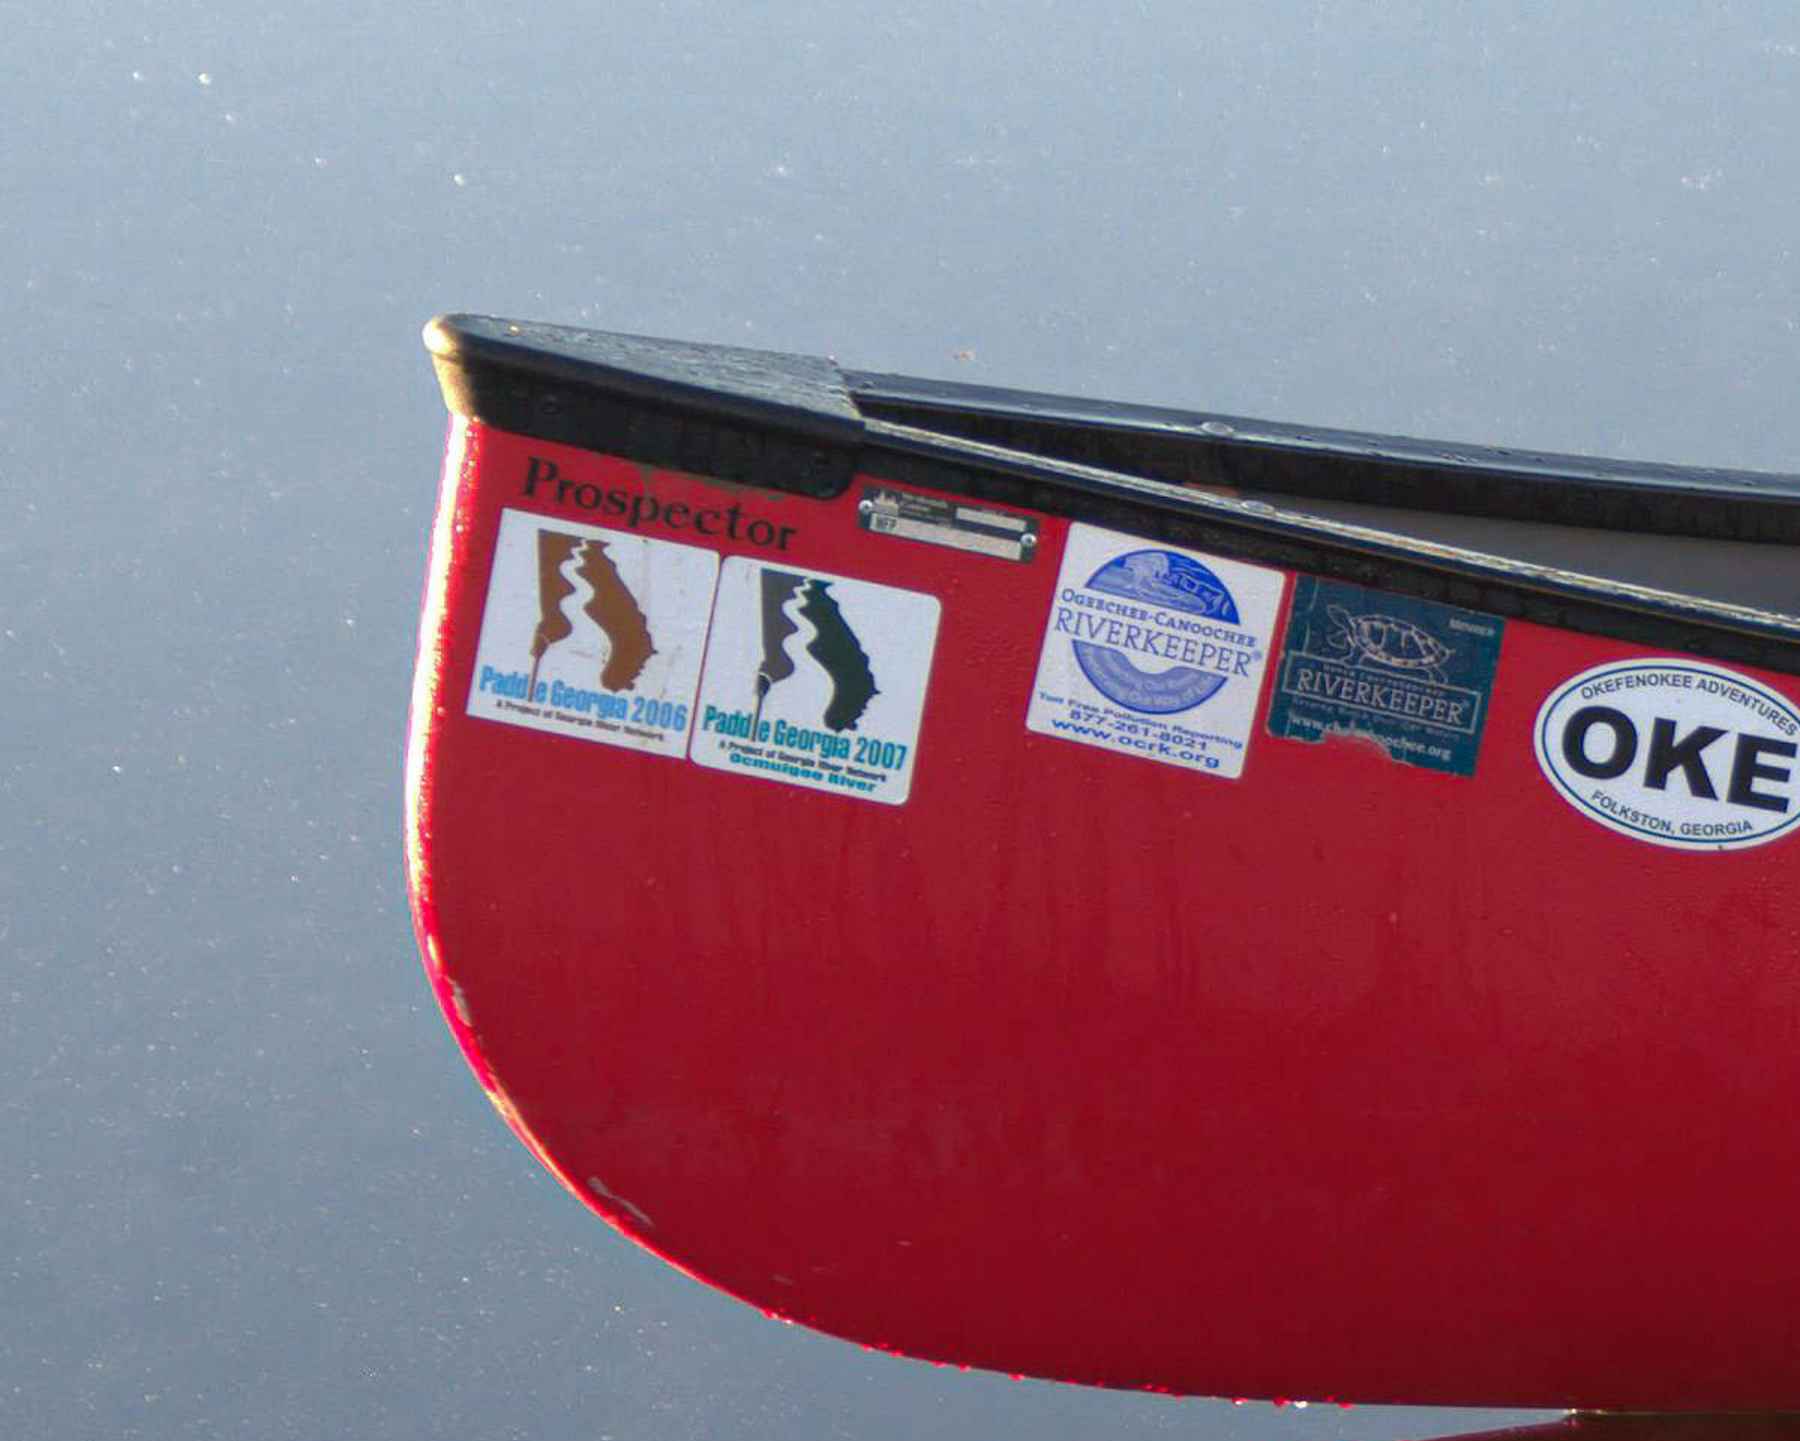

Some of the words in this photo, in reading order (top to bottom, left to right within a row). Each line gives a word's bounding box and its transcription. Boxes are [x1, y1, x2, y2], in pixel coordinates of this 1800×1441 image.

[523, 456, 798, 550] Prospector
[1054, 605, 1252, 678] RIVERKEEPER
[550, 679, 629, 721] Georgia
[631, 694, 689, 732] 2006
[1296, 667, 1465, 727] RIVERKEEPER
[1580, 672, 1693, 701] OKEFENOKEE
[1696, 678, 1798, 737] ADVENTURES
[702, 704, 771, 743] Paddle
[774, 718, 852, 760] Georgia
[853, 736, 909, 771] 2007
[1051, 718, 1221, 769] www.ocrk.org
[1562, 705, 1798, 814] OKE
[1591, 789, 1676, 836] FOLKSTON,
[1679, 820, 1754, 837] GEORGIA
